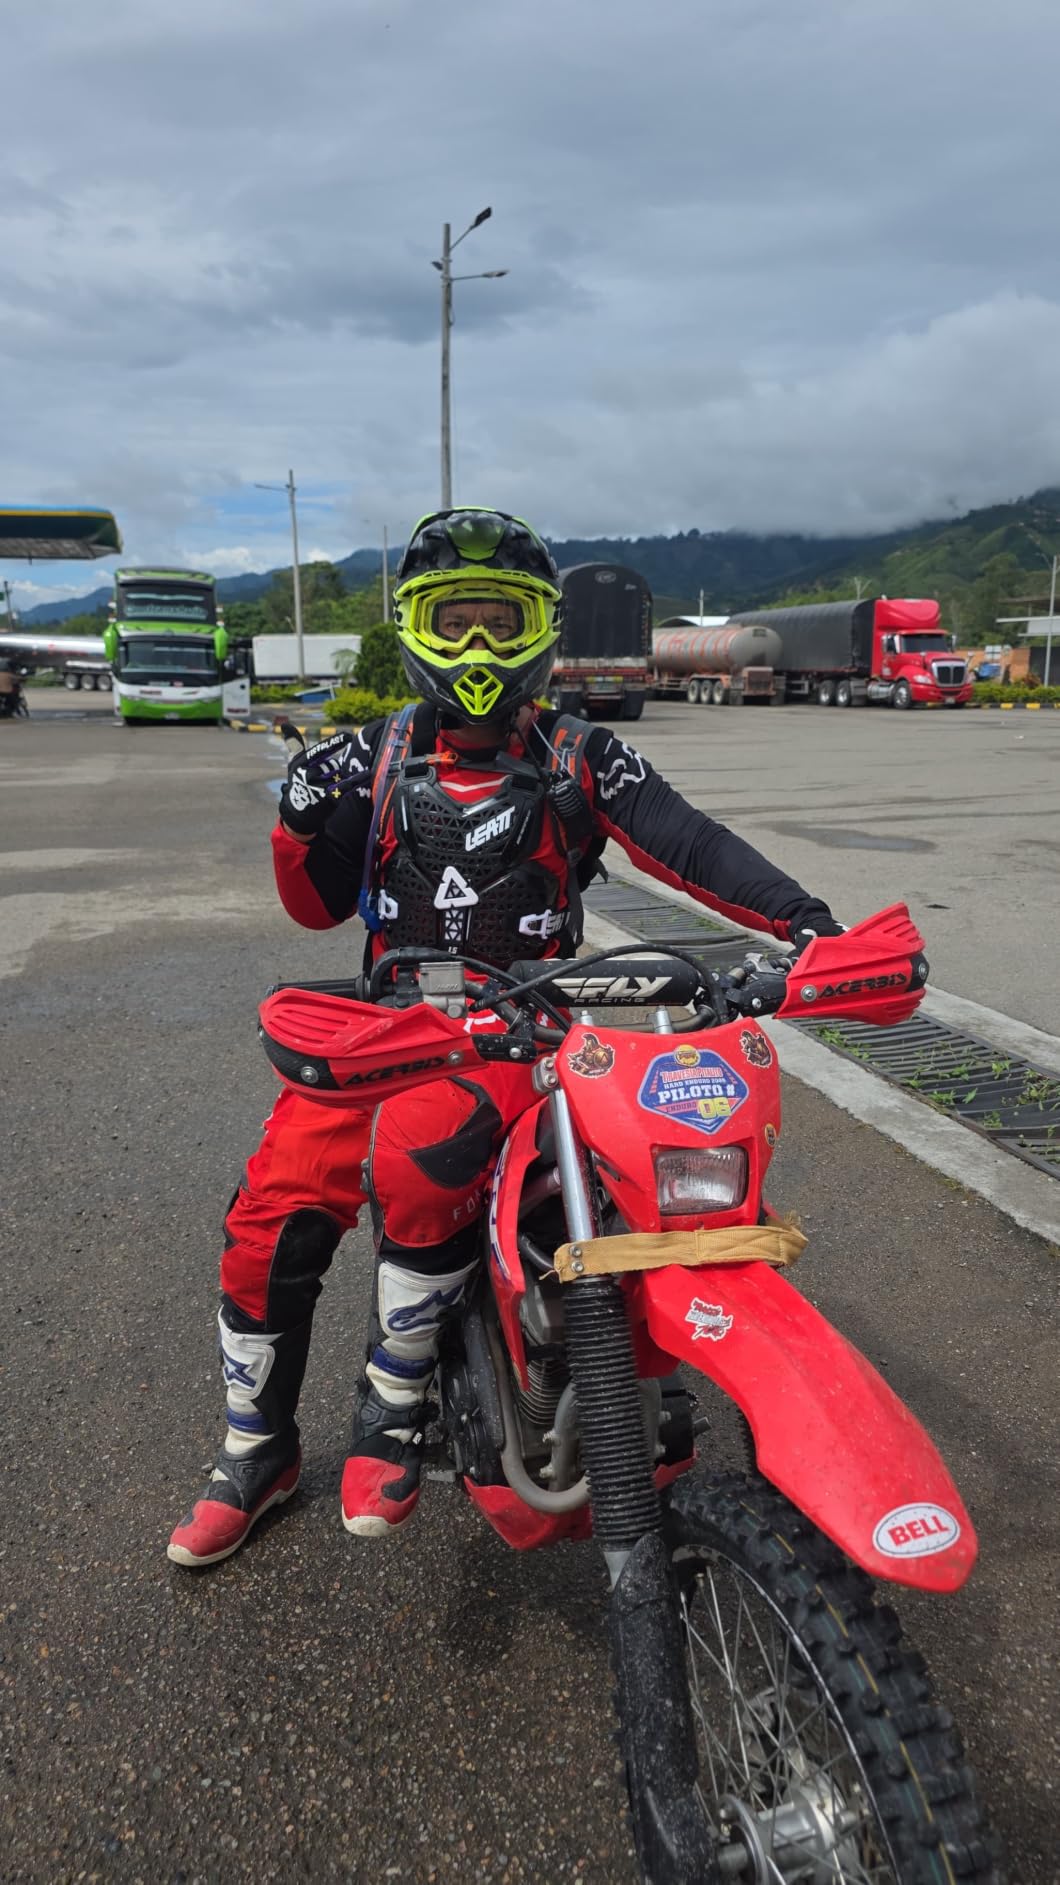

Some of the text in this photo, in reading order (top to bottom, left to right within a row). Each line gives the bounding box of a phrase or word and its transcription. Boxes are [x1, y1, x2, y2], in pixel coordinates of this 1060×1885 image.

[465, 806, 516, 852] LEATT
[552, 976, 673, 999] FLY
[819, 972, 907, 999] ACERBIS
[658, 1084, 724, 1104] PILOTO
[663, 1080, 684, 1090] HARD
[697, 1096, 732, 1119] 06
[888, 1515, 951, 1547] BELL
